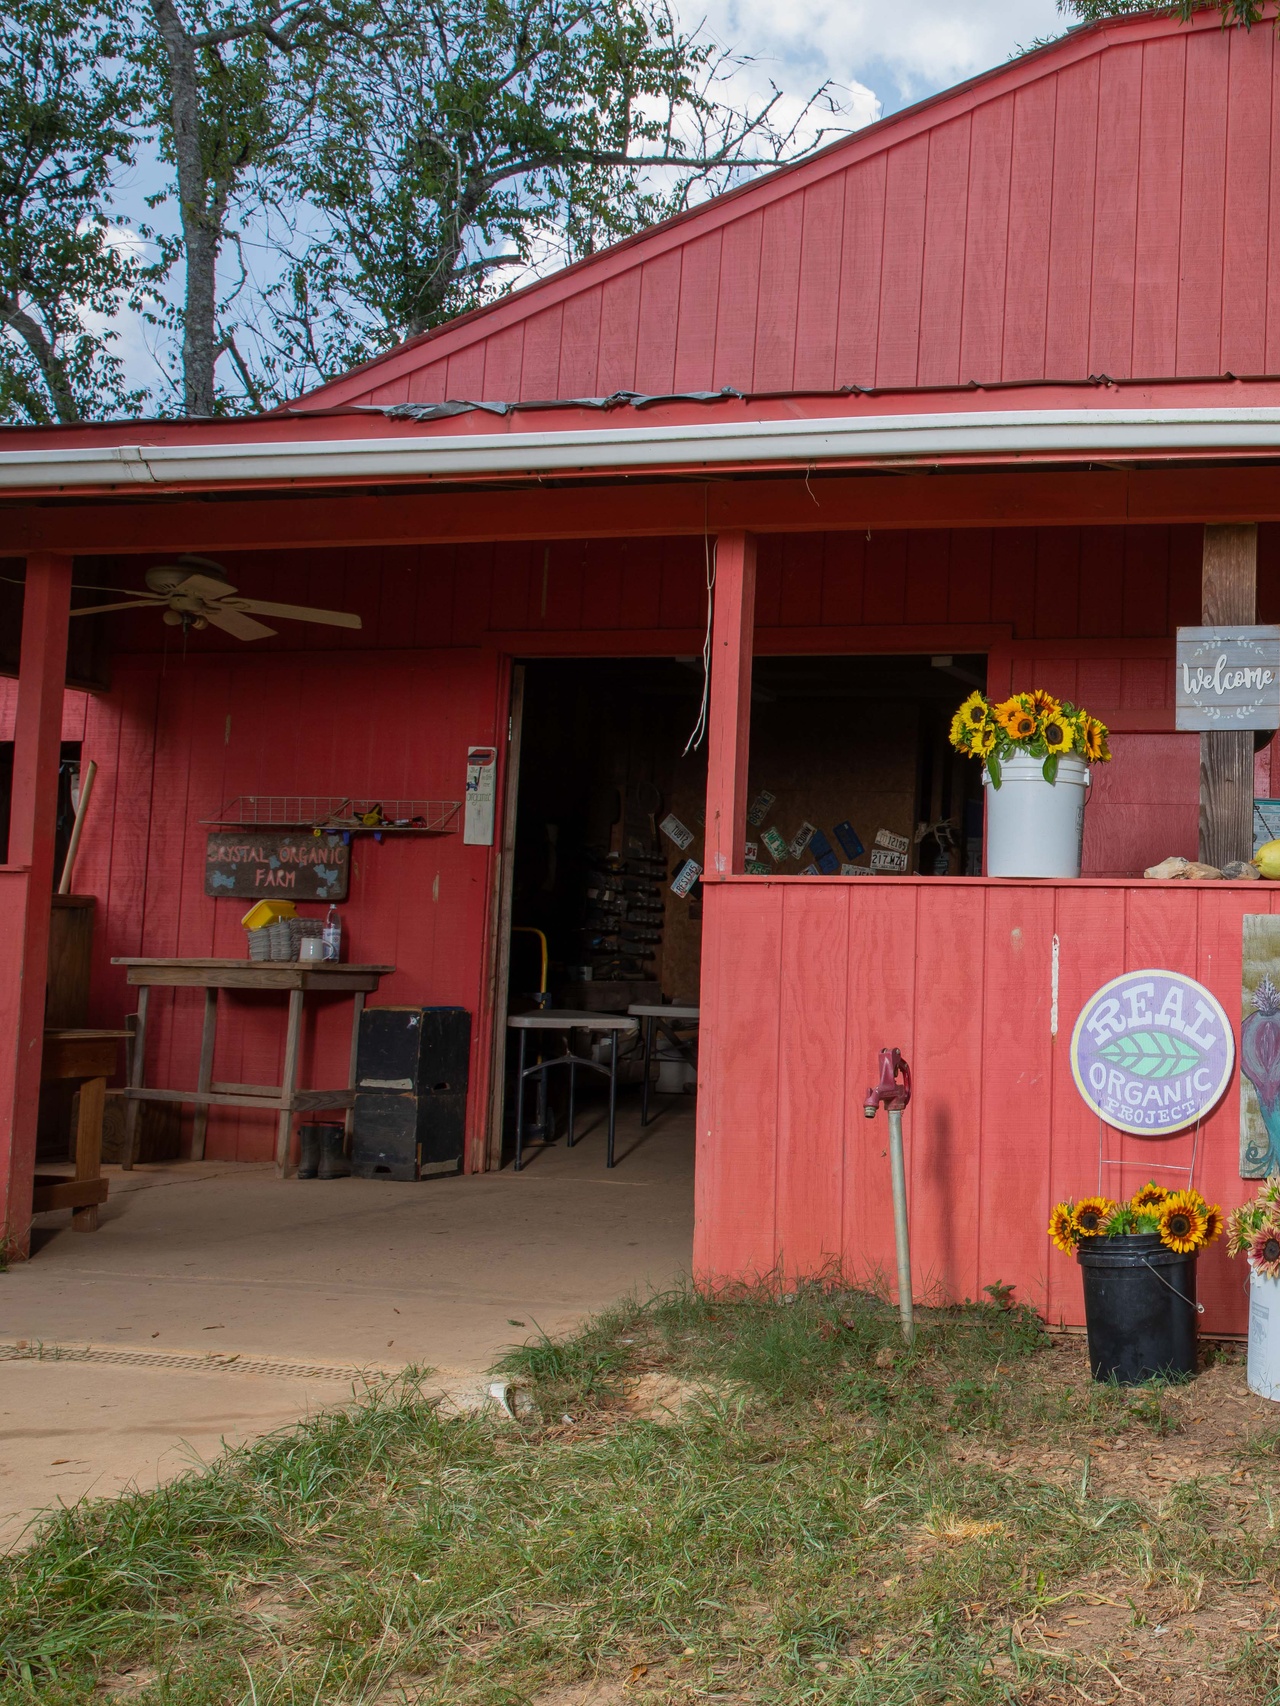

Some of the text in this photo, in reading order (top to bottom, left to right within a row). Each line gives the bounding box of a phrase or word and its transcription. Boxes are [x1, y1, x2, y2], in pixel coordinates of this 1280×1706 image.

[1182, 654, 1273, 696] Welcome
[208, 844, 344, 865] CRYSTAL ORGANIC
[871, 854, 888, 865] 217
[255, 869, 296, 887] FARM
[1087, 983, 1217, 1051] REAL
[1089, 1062, 1212, 1107] ORGANIC
[1104, 1097, 1196, 1124] PROJECT
